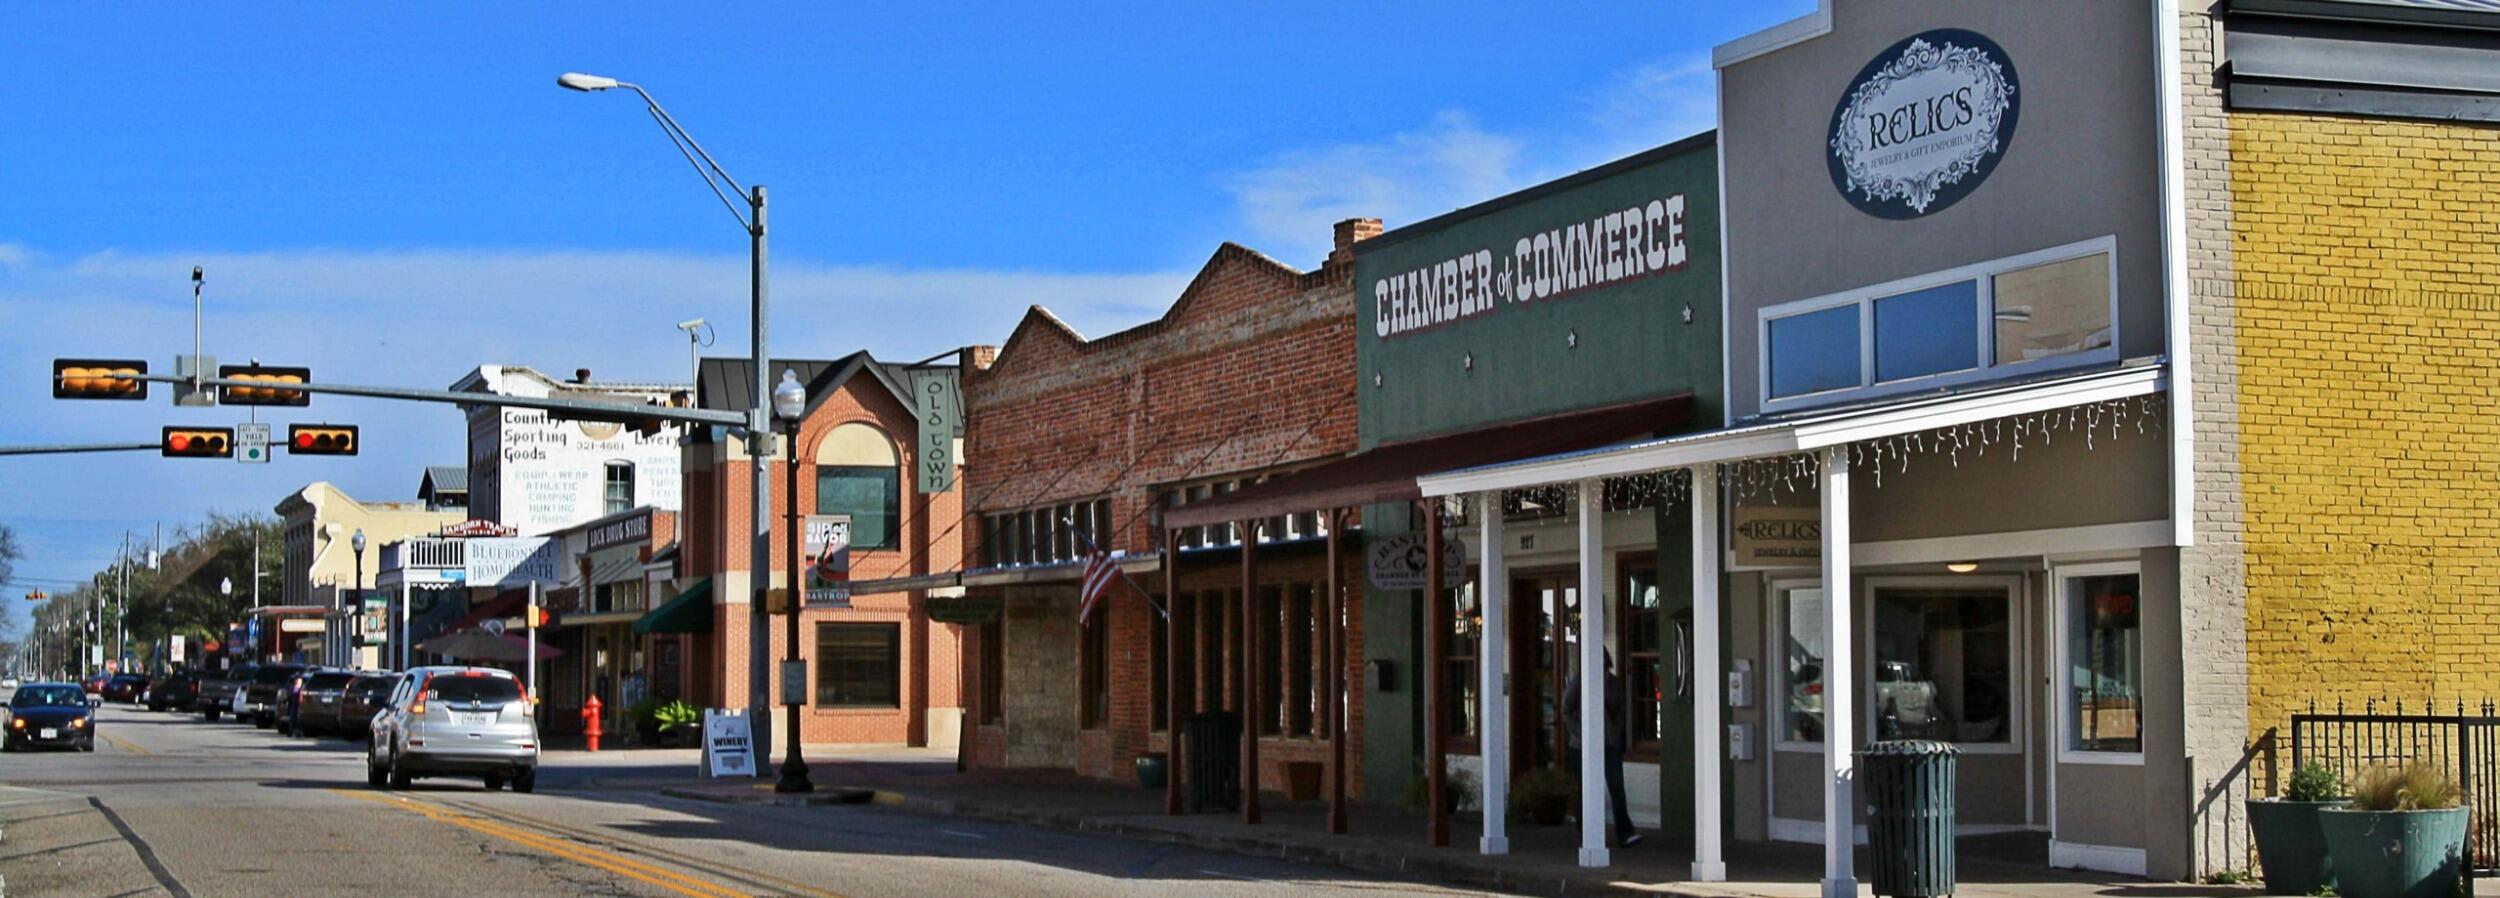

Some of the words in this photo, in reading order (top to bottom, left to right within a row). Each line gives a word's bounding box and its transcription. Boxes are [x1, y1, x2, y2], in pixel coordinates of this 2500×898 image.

[1869, 86, 1973, 151] RELICS
[1375, 249, 1494, 338] CHAMBER
[1497, 256, 1513, 304] of
[1515, 194, 1687, 302] COMMERCE
[504, 428, 567, 447] Sporting
[504, 446, 546, 464] Goods
[483, 520, 516, 535] TRAVEL
[606, 521, 624, 544] DRUG
[625, 515, 647, 539] STORE
[806, 533, 847, 544] SAVOR
[472, 541, 552, 559] BLUEBONNET
[473, 563, 505, 581] HOME
[508, 563, 553, 580] HEALTH
[713, 736, 748, 747] WINERY
